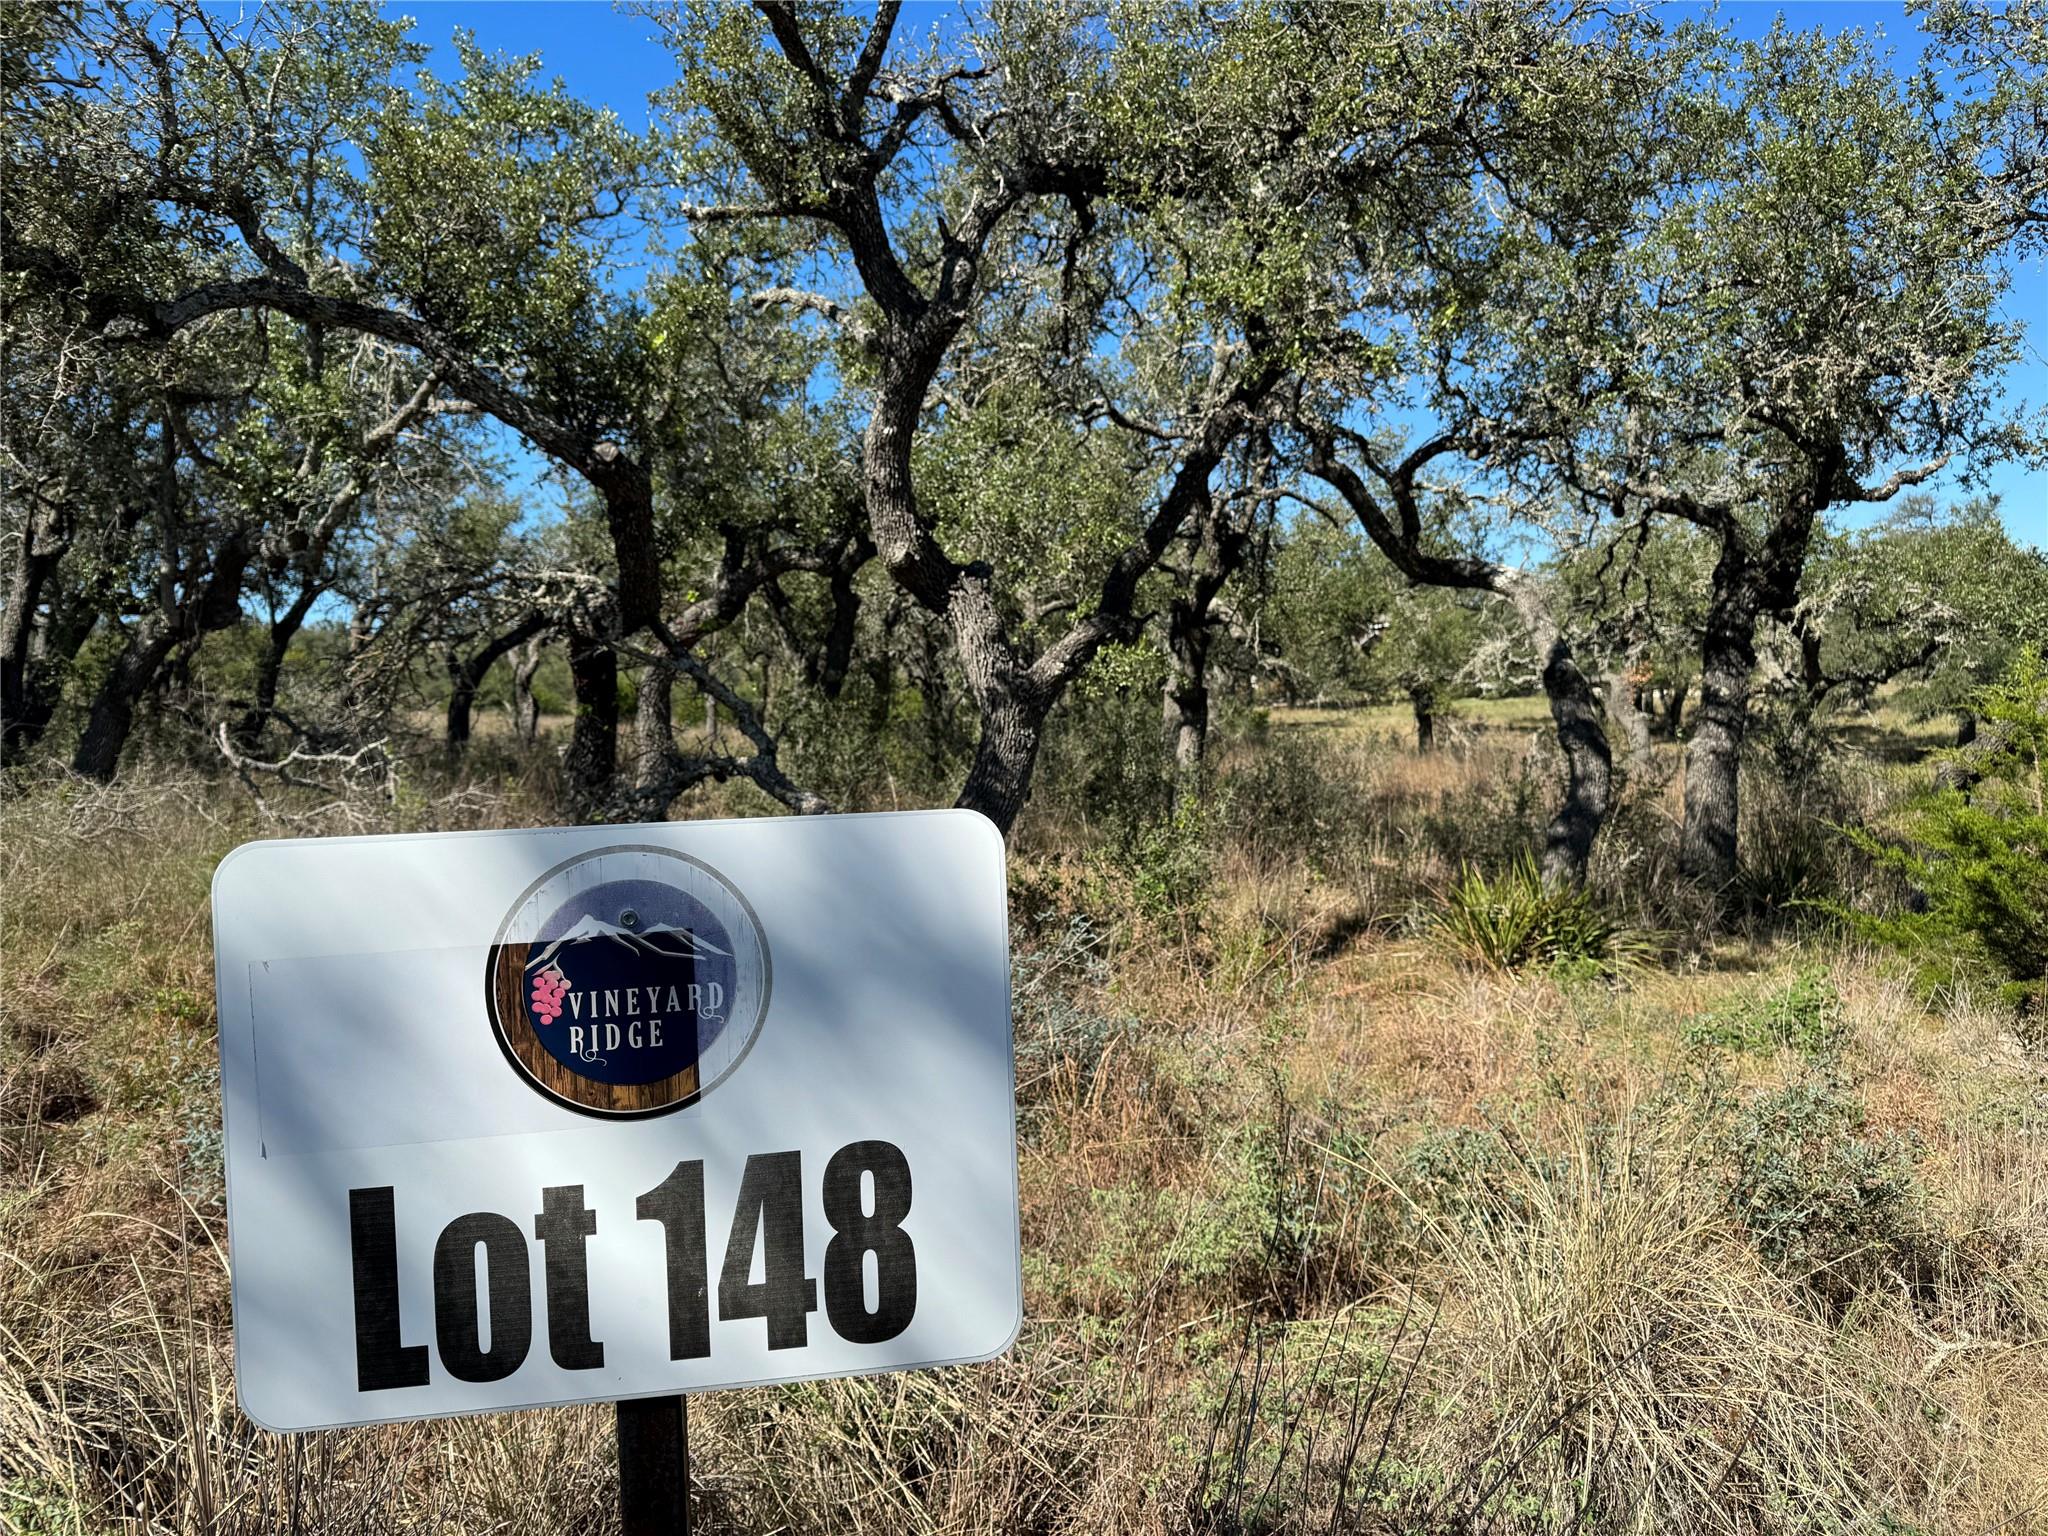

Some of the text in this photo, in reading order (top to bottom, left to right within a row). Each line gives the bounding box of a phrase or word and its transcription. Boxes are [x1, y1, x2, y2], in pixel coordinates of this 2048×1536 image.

[568, 982, 725, 1023] VINEYARD
[569, 1019, 664, 1066] RIDGE
[349, 1139, 918, 1392] Lot 148
